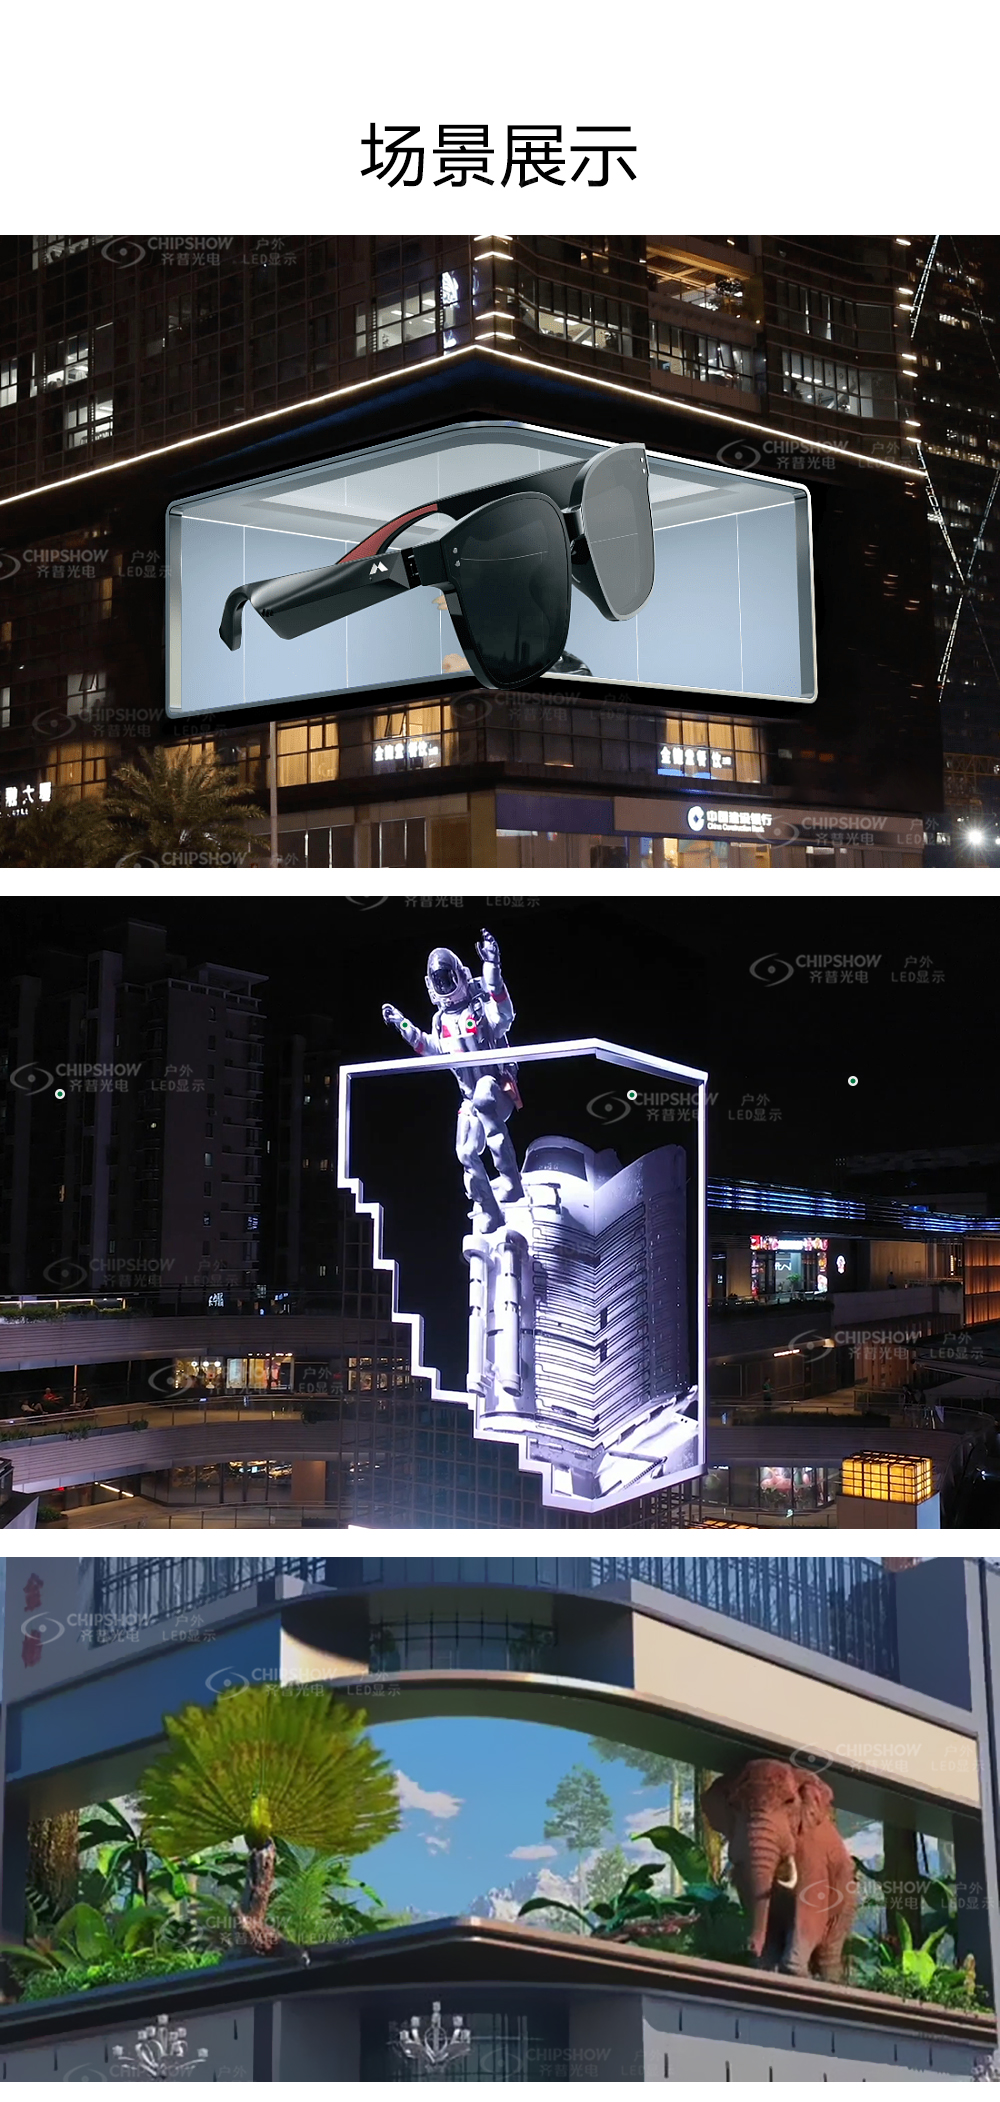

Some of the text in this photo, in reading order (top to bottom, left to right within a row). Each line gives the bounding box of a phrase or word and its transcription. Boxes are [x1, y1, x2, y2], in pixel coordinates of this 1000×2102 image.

[706, 810, 773, 827] 中国建设银行
